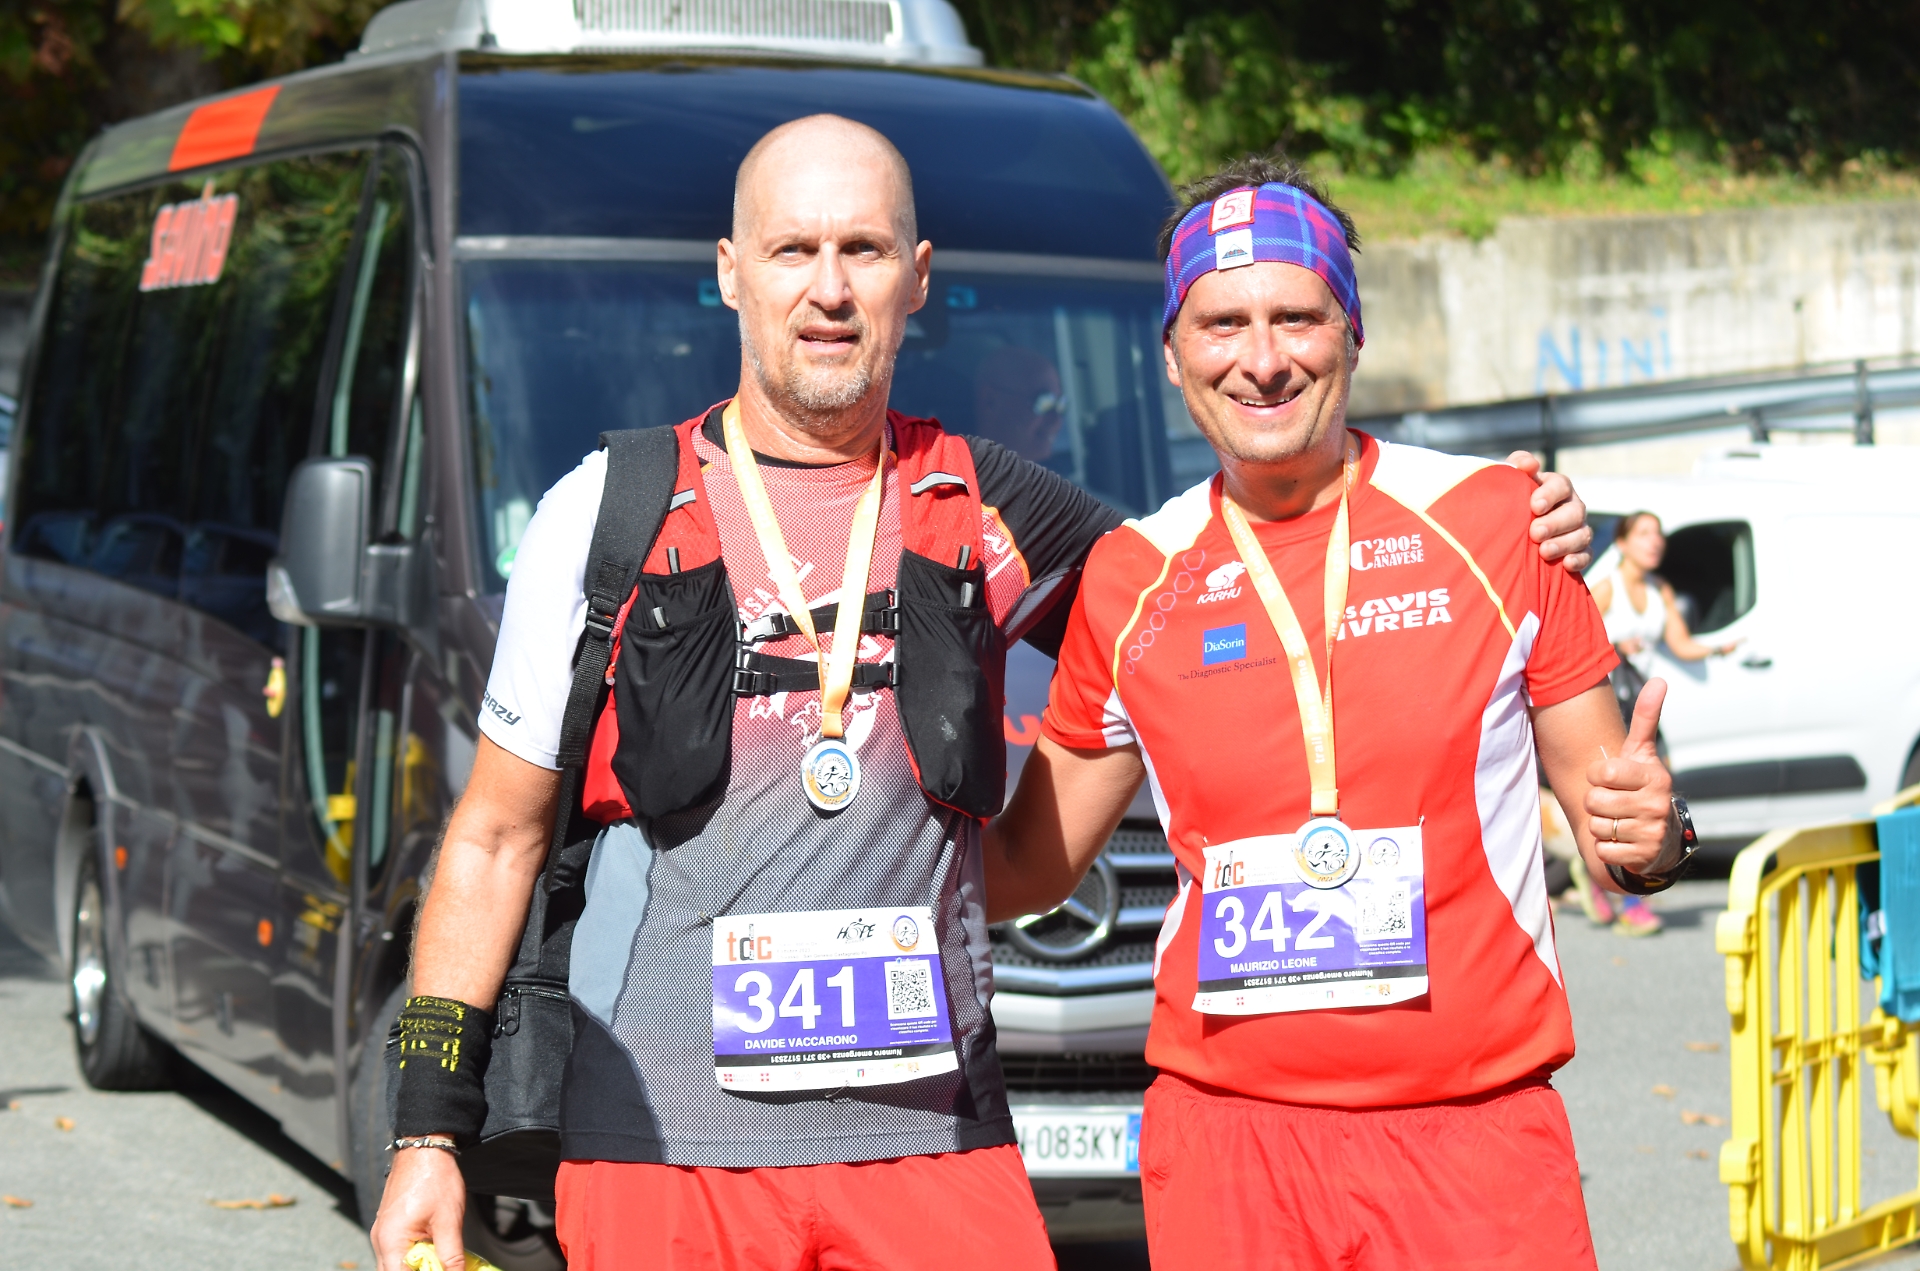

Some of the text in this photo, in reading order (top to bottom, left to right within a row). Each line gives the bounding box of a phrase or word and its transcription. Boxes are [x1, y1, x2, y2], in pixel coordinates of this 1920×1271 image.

[1373, 534, 1423, 555] 2005
[1350, 540, 1424, 571] CANAVESE
[1196, 586, 1242, 605] KARHU
[1359, 588, 1450, 617] AVIS
[1336, 606, 1452, 641] IVREA
[1204, 637, 1245, 654] DiaSorin
[1178, 656, 1277, 681] The Diagnostic Specialist
[1310, 736, 1326, 764] trail
[1214, 850, 1244, 889] tdc
[1213, 889, 1335, 958] 342
[727, 922, 877, 961] tdc HOPE
[1230, 957, 1318, 974] MAURIZIO LEONE
[1342, 969, 1374, 978] Numero
[1273, 976, 1287, 984] 371
[1288, 975, 1302, 983] +39
[1302, 971, 1342, 982] emergenza
[734, 966, 856, 1034] 341
[744, 1034, 858, 1050] DAVIDE VACCARONO
[770, 1048, 902, 1063] Numero emergenza +39 371 5172531
